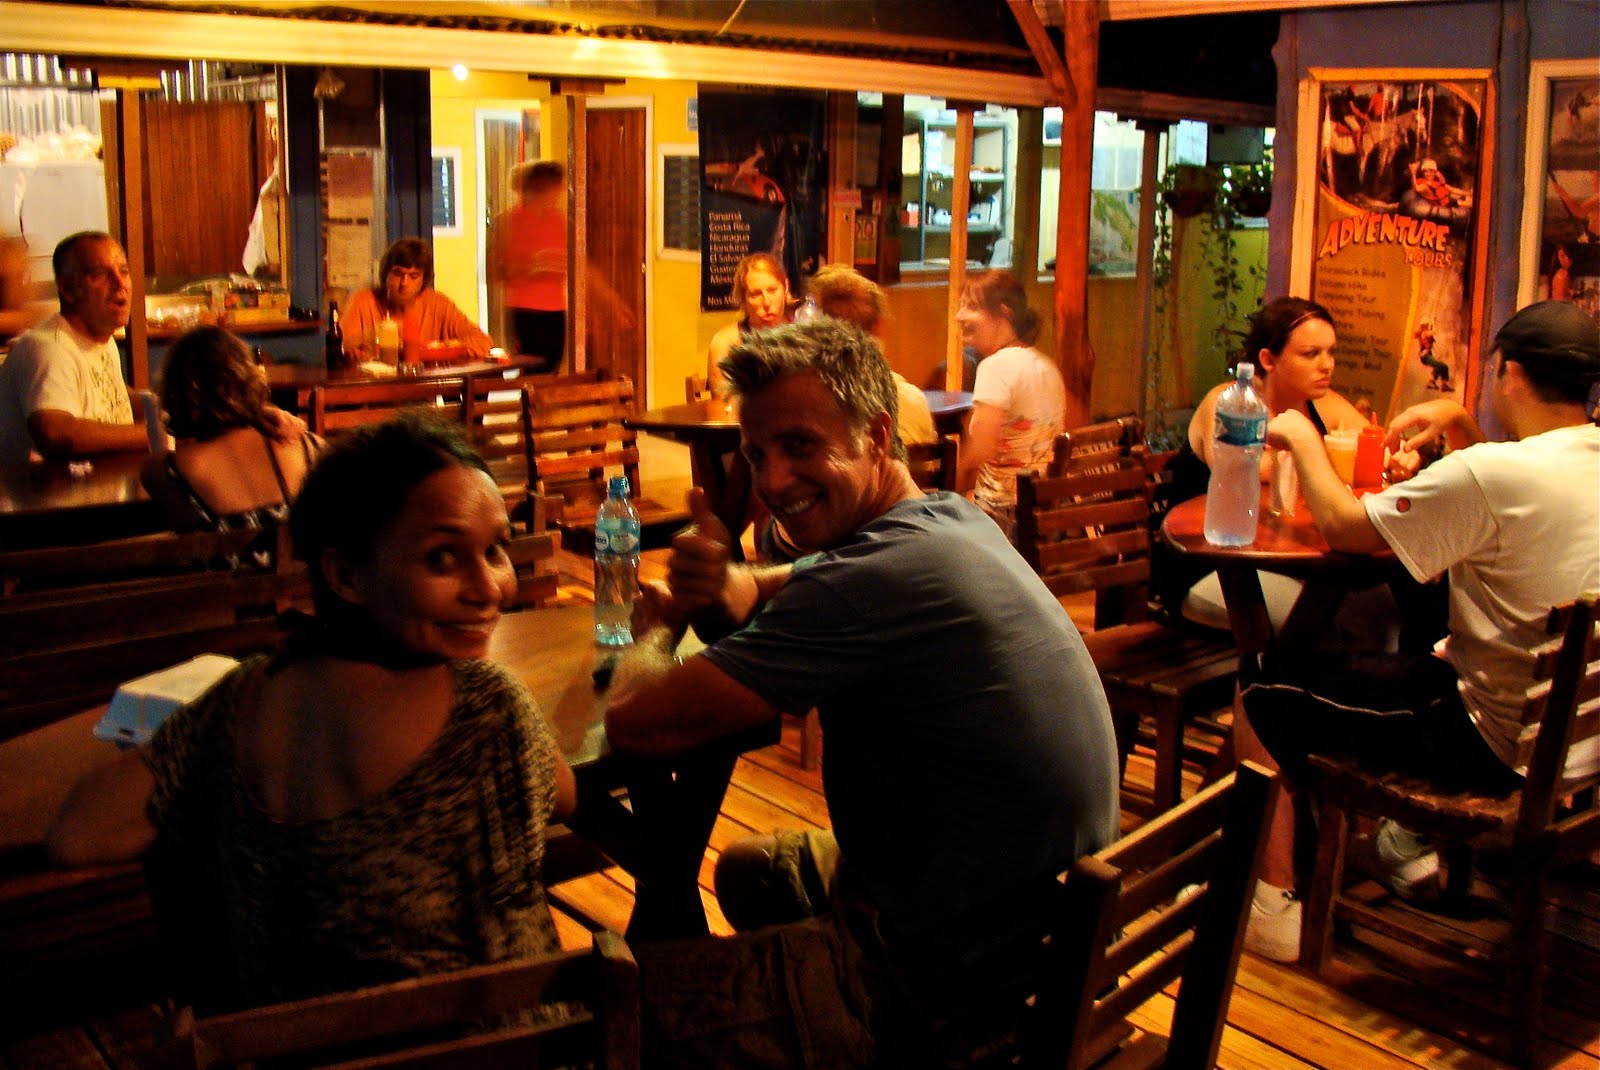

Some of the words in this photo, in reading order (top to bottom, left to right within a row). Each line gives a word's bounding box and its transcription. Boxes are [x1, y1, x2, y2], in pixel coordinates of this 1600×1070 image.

[708, 210, 742, 221] Panamá
[708, 222, 732, 233] Costa
[733, 222, 751, 232] Rica
[709, 232, 751, 243] Nicaragua
[1318, 212, 1450, 260] ADVENTURE
[709, 243, 749, 253] Honduras
[1404, 247, 1453, 268] TOURS
